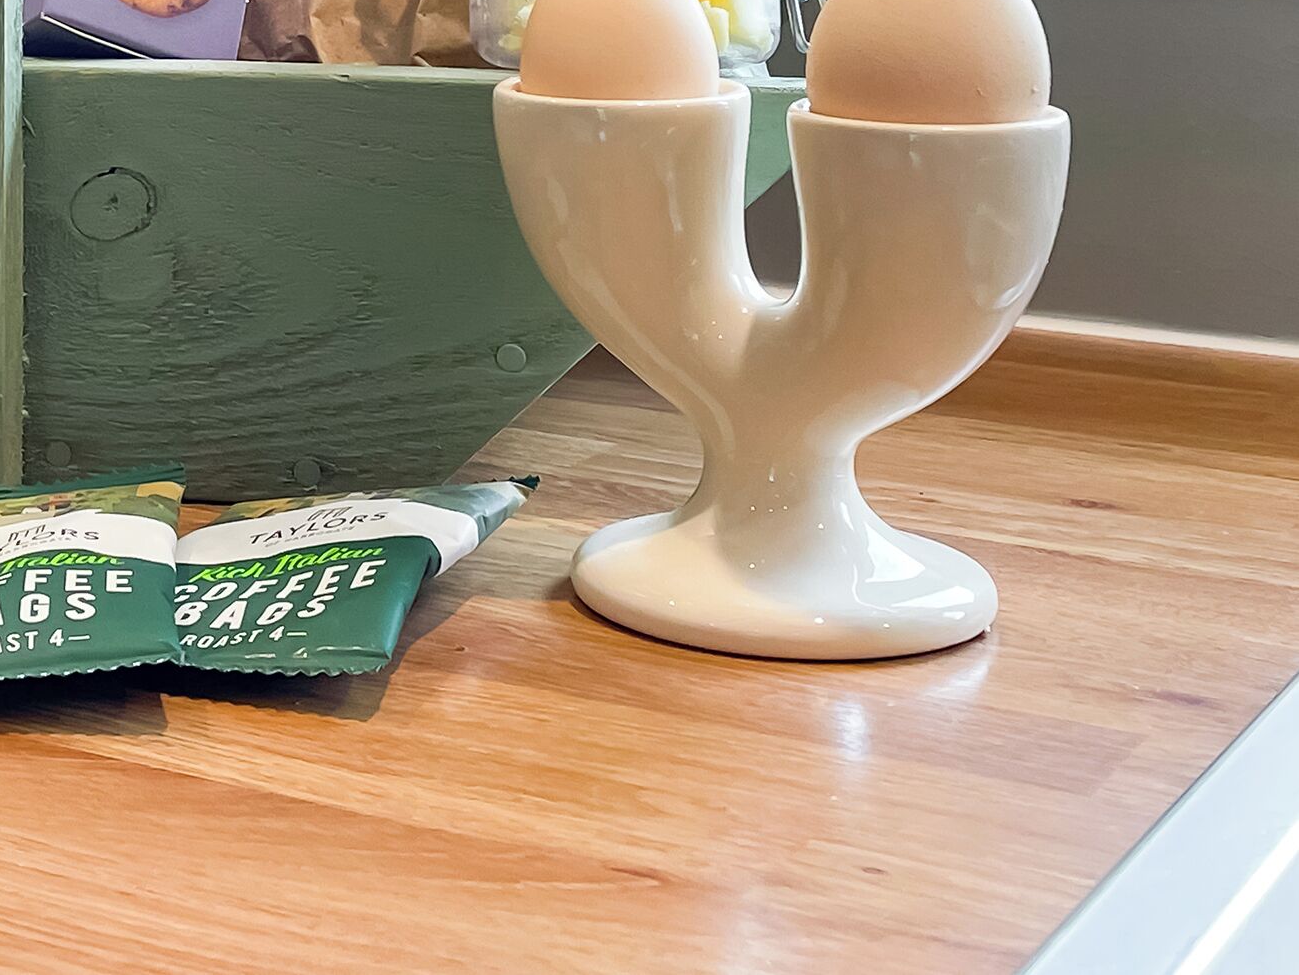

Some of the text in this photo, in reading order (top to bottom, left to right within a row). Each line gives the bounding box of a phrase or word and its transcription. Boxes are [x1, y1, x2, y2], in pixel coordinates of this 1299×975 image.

[250, 512, 389, 545] TAYLORS
[174, 559, 387, 603] COFFEE
[188, 545, 387, 583] Rich Italian
[174, 594, 335, 630] BAGS
[49, 628, 64, 647] 4
[179, 626, 284, 649] ROAST 4
